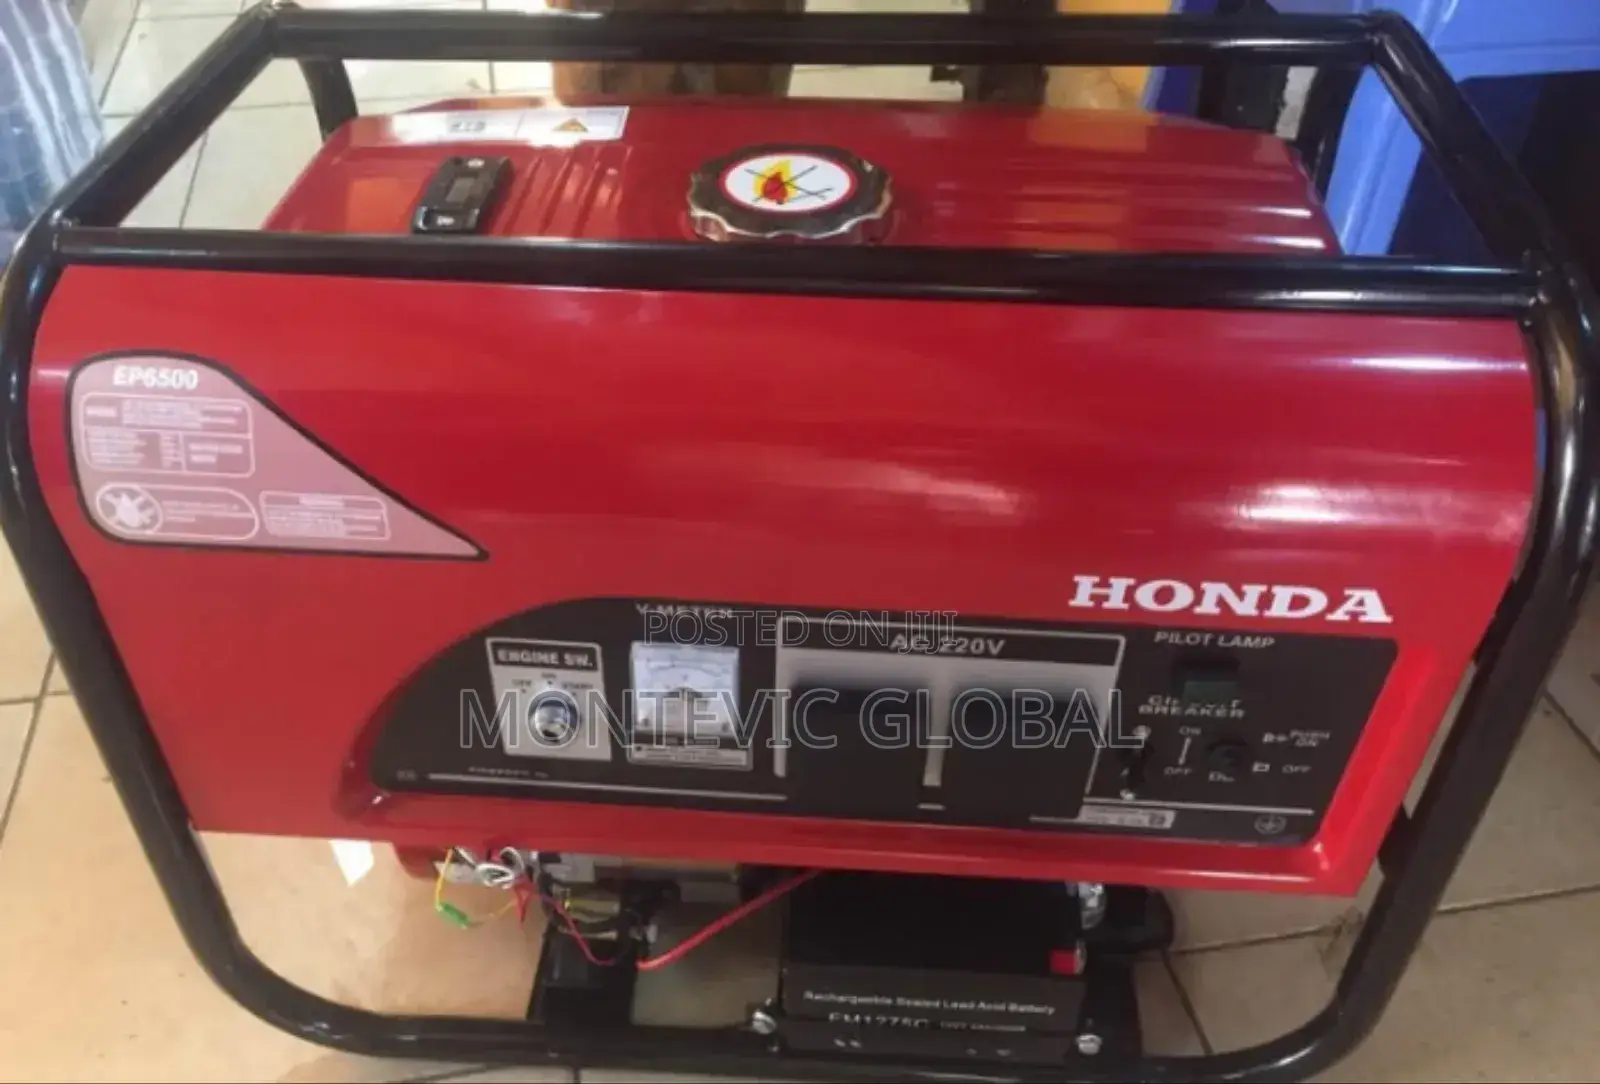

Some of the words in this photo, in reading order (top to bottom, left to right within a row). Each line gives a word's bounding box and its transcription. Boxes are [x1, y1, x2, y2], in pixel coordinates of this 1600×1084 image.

[112, 364, 199, 391] EP6500
[1068, 574, 1394, 624] HONDA
[938, 635, 1006, 656] 220V
[1153, 630, 1214, 647] PILOT
[1217, 634, 1276, 649] LAMP
[497, 648, 560, 665] ENGINE
[1137, 703, 1247, 720] BREAKER
[802, 989, 892, 1005] Rechargeable
[942, 999, 972, 1011] Lead
[1005, 1002, 1054, 1017] Battery
